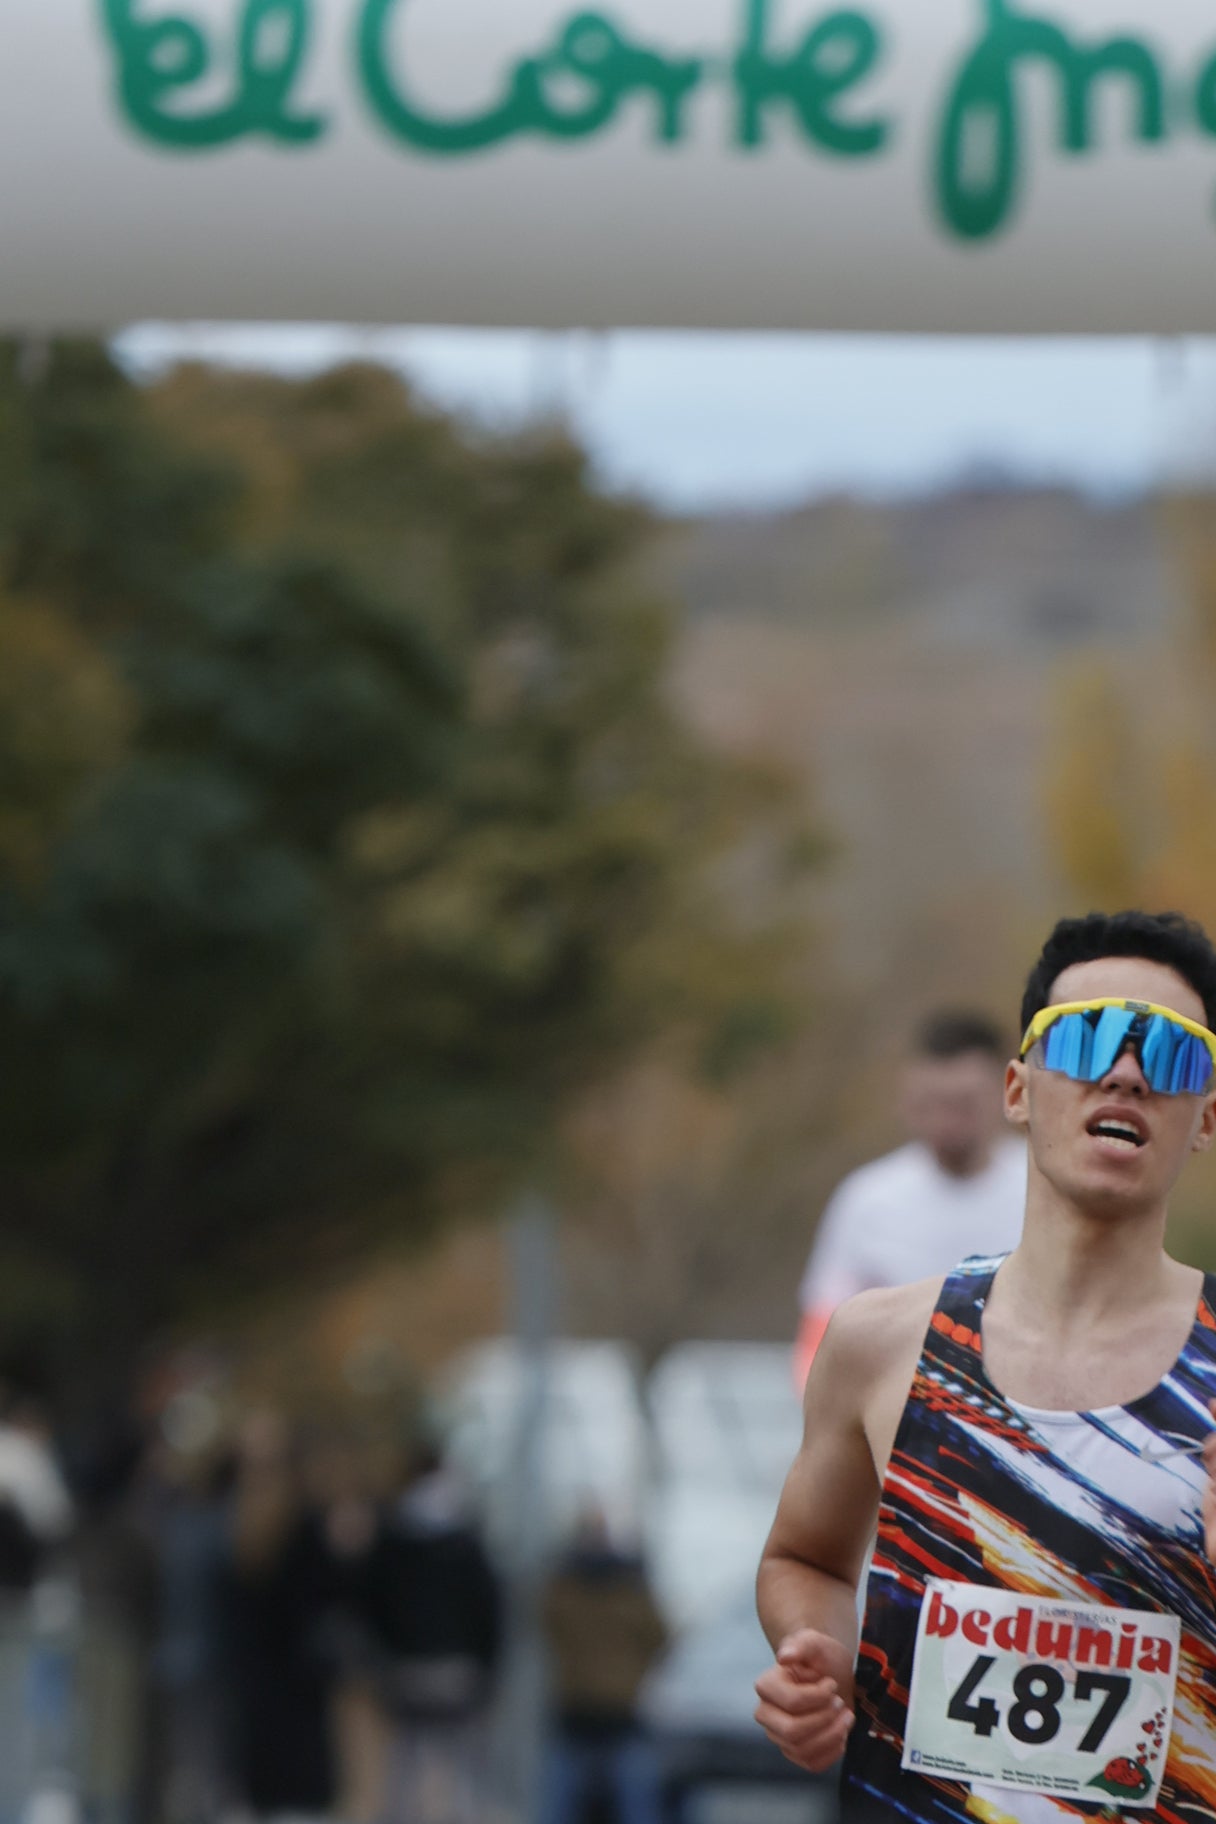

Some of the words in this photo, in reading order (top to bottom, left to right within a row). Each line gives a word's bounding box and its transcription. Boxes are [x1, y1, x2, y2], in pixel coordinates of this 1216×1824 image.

[354, 0, 888, 157] Corte
[925, 1591, 1173, 1675] bedunia
[947, 1655, 1131, 1753] 487
